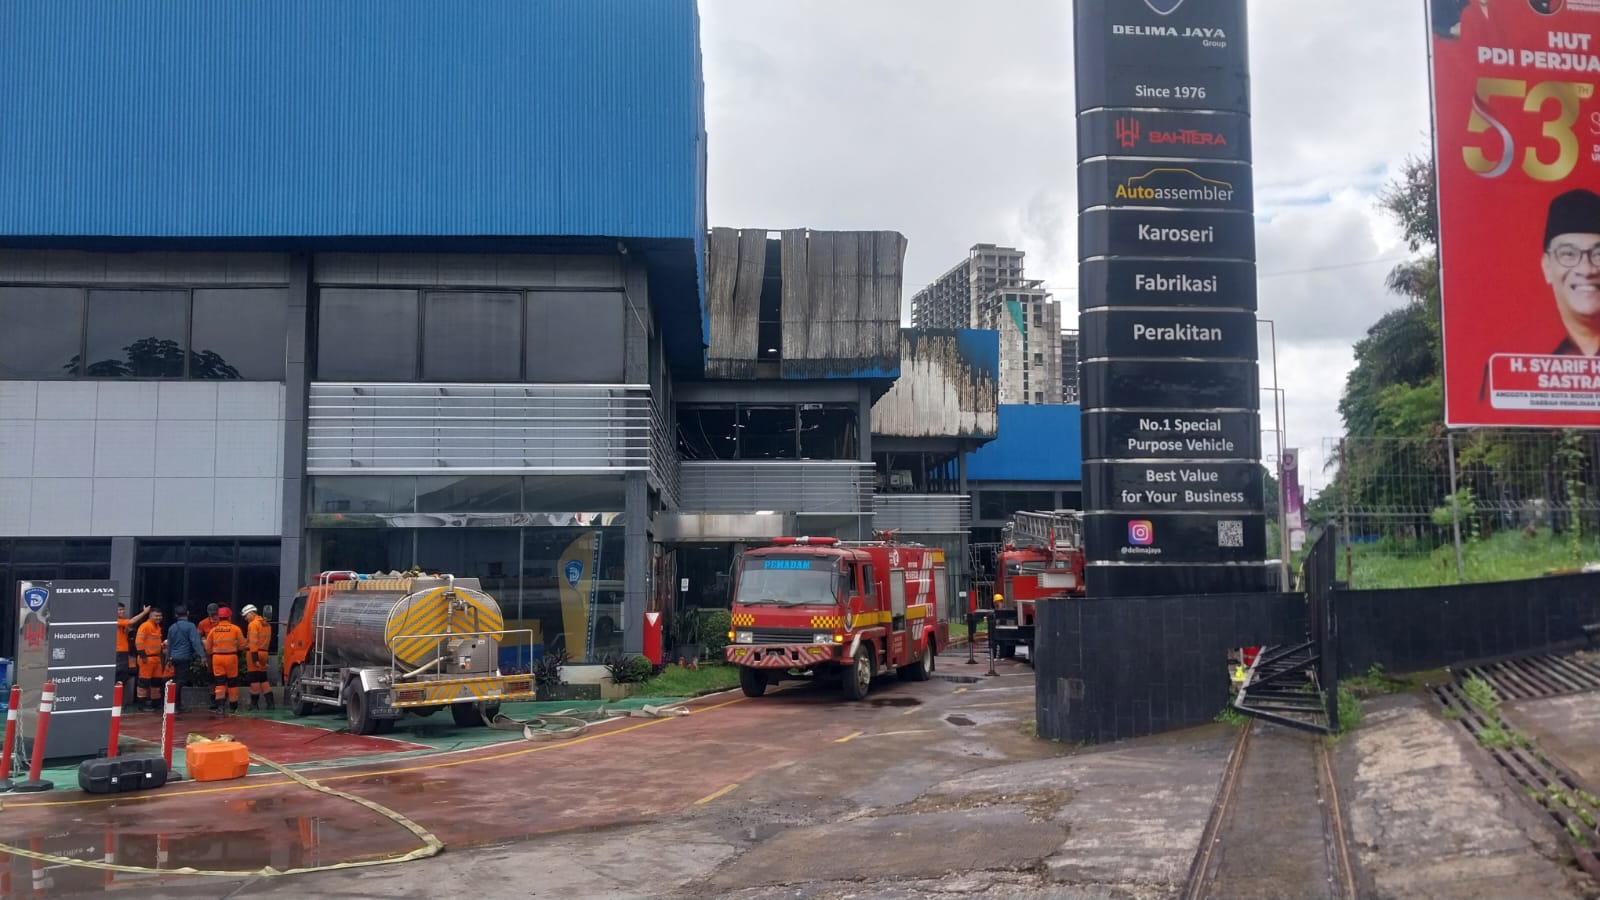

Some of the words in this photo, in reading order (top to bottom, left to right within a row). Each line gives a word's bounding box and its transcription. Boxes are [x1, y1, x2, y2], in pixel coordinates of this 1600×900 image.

[1113, 24, 1178, 36] DELIMA
[1182, 27, 1226, 38] JAYA
[1202, 39, 1227, 48] Group
[1548, 31, 1591, 50] HUT
[1478, 46, 1515, 66] PDI
[1135, 85, 1170, 98] Since
[1174, 86, 1206, 99] 1976
[1149, 129, 1227, 145] BAHTERA
[1462, 77, 1593, 182] 53
[1116, 184, 1234, 201] Autoassembler
[1138, 224, 1214, 243] Karoseri
[1135, 274, 1217, 292] Fabrikasi
[1133, 323, 1222, 341] Perakitan
[1510, 358, 1527, 373] H.
[1530, 359, 1588, 374] SYARIF
[1139, 418, 1171, 431] No.1
[1174, 418, 1222, 434] Special
[1128, 438, 1183, 453] Purpose
[1186, 438, 1234, 451] Vehicle
[1146, 469, 1176, 482] Best
[1180, 469, 1218, 482] Value
[1122, 490, 1142, 503] for
[1145, 490, 1177, 503] Your
[1185, 490, 1244, 503] Business
[764, 560, 811, 570] PEMADAM
[52, 676, 70, 684] Head
[72, 675, 92, 683] Office
[54, 695, 77, 703] actory
